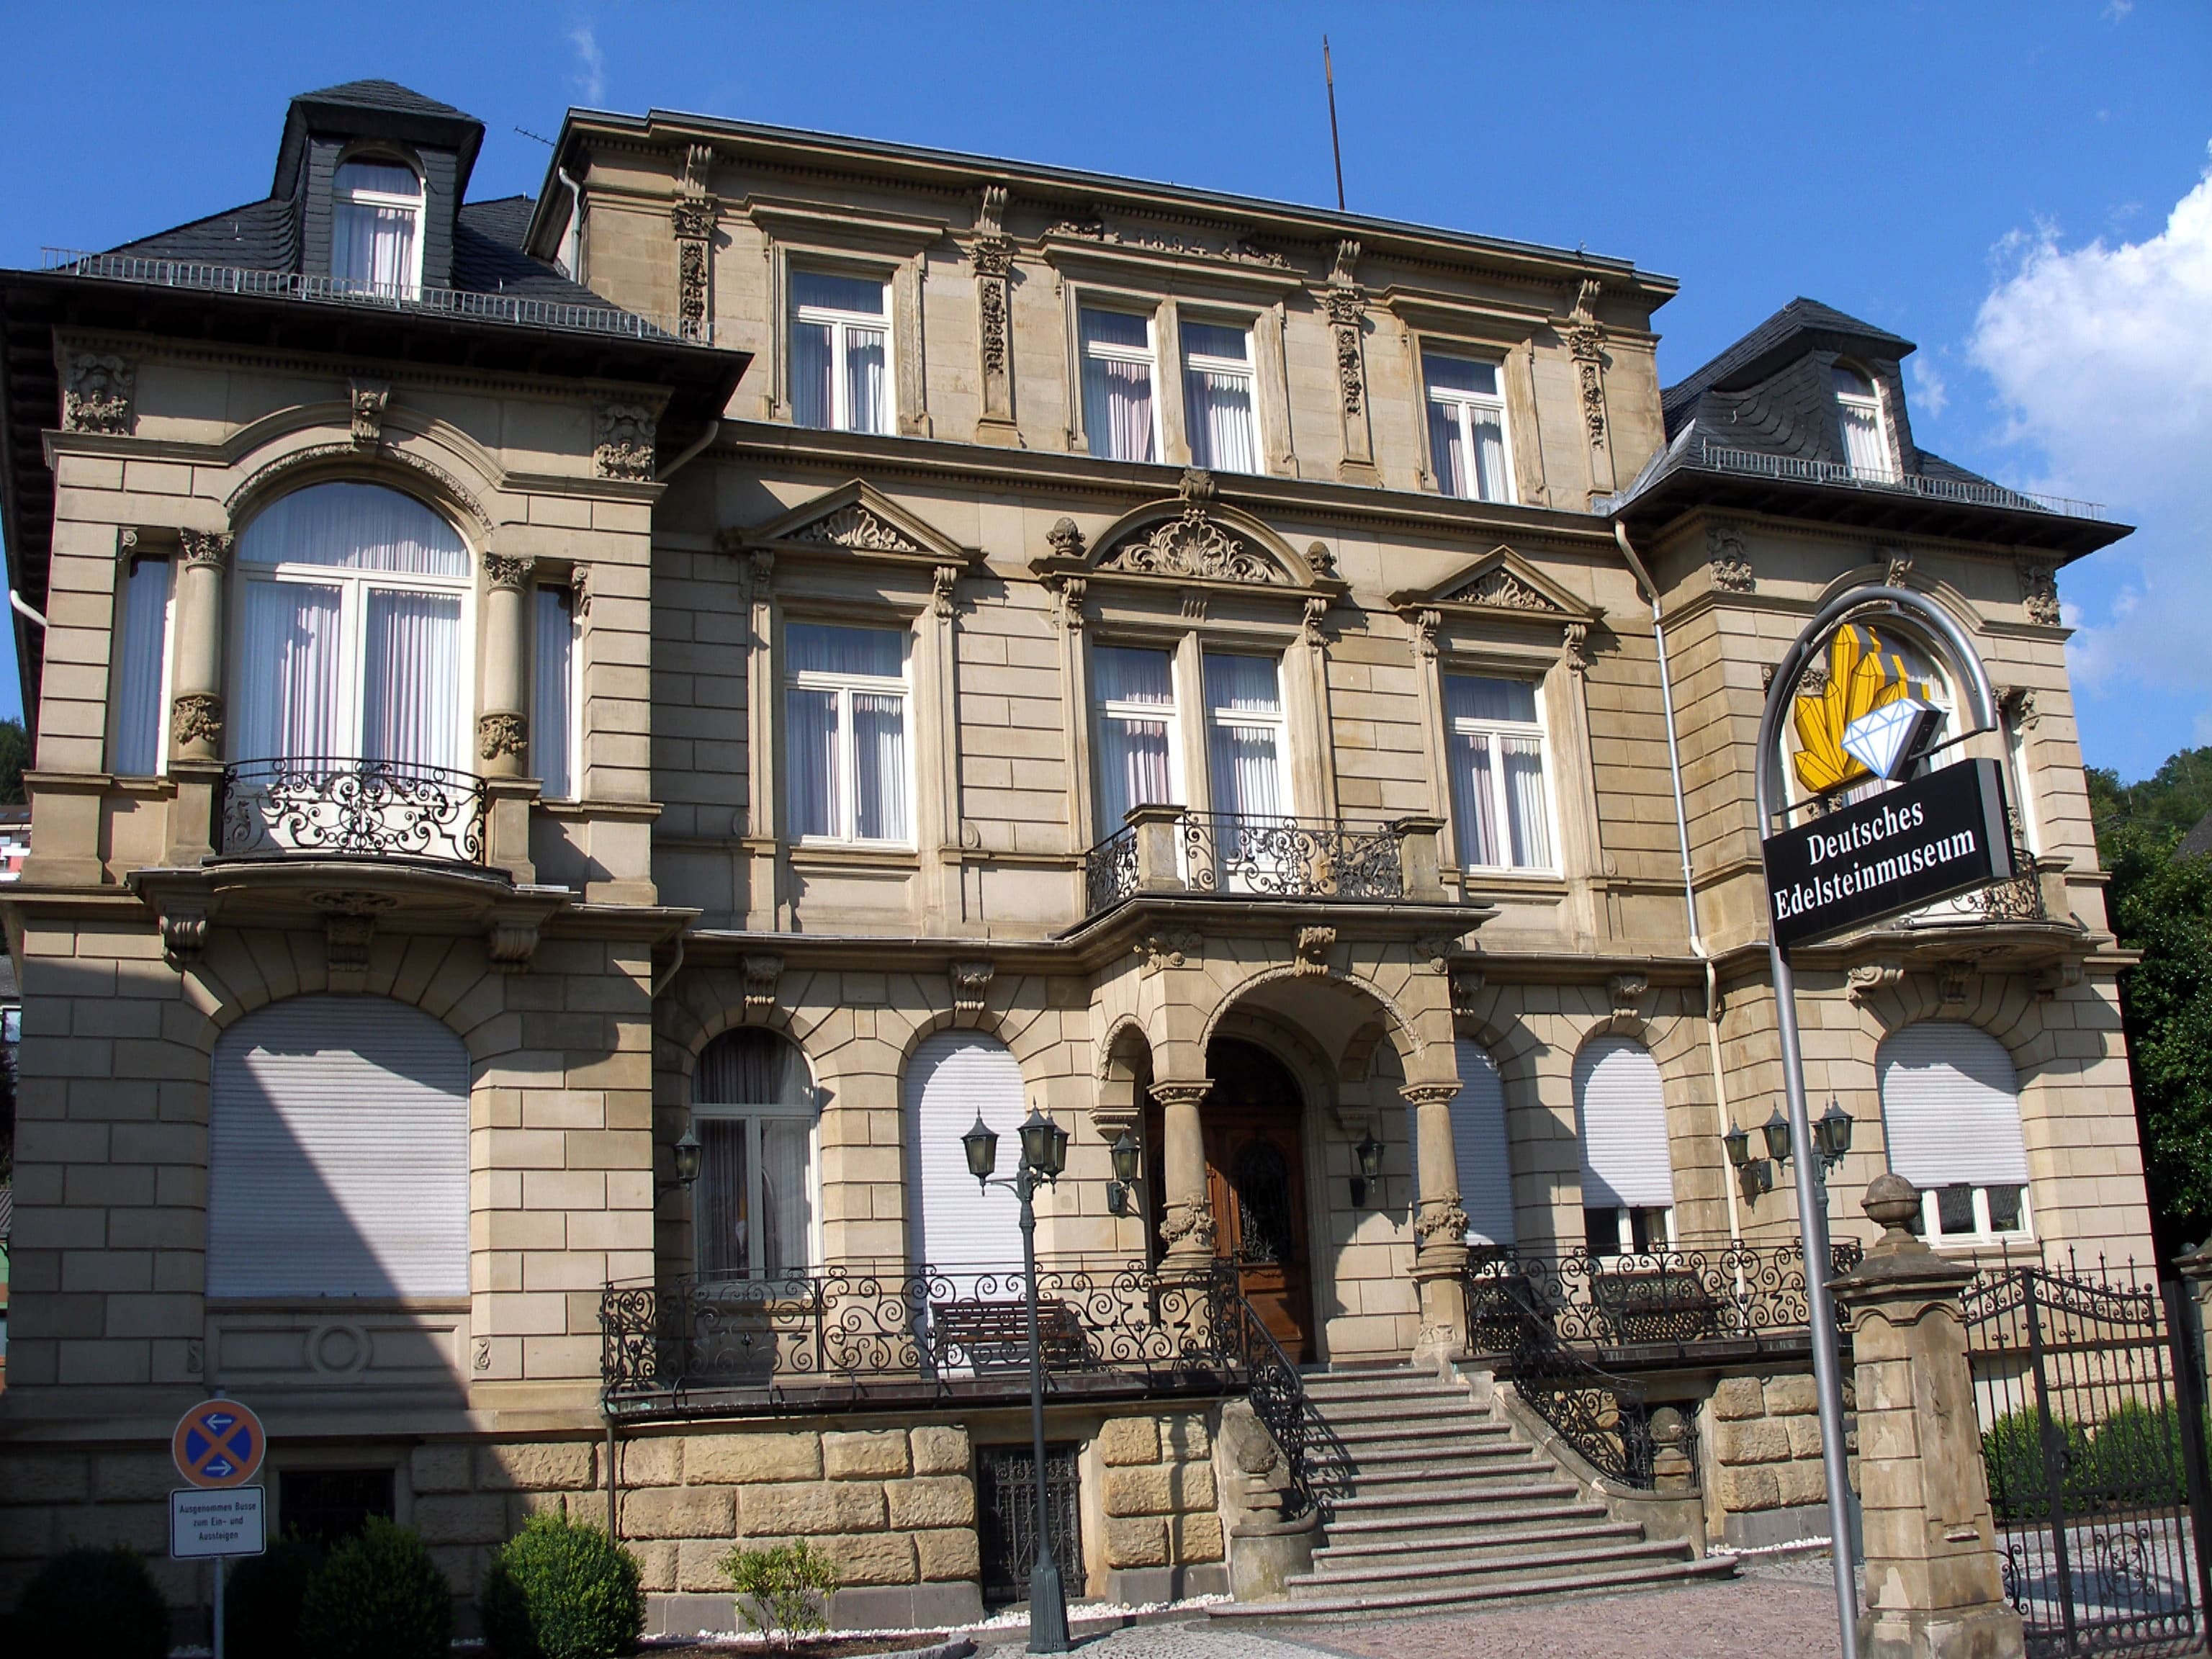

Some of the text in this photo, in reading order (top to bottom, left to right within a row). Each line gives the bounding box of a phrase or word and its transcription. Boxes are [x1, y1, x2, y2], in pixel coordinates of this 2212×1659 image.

[1807, 801, 1925, 866] Deutsches
[1773, 829, 1977, 921] Edelsteinmuseum
[180, 1502, 256, 1514] Ausgenommen Busse
[211, 1516, 227, 1526] Ein-
[230, 1515, 243, 1524] und
[199, 1532, 239, 1542] Aussteigen
